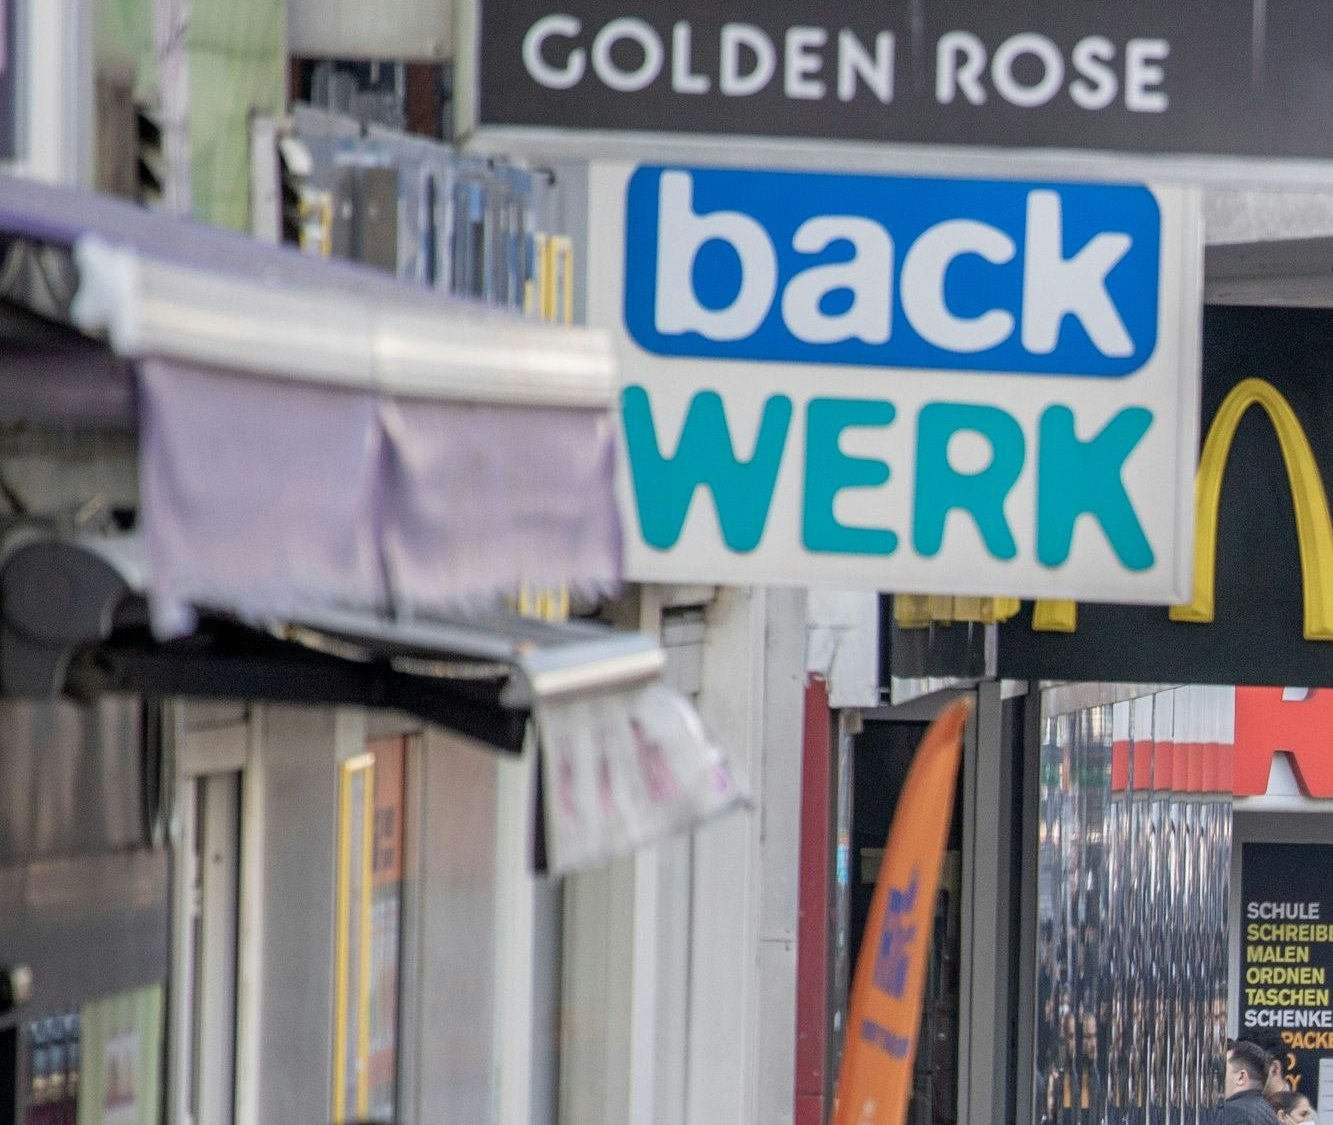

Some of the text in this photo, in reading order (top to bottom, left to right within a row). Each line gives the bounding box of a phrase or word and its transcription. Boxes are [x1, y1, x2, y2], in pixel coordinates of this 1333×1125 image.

[522, 13, 1172, 114] GOLDEN ROSE
[654, 170, 1136, 358] back
[622, 384, 1156, 572] WERK
[1246, 901, 1321, 920] SCHULE
[1246, 945, 1310, 963] MALEN
[1245, 966, 1326, 985] ORDNEN
[1245, 988, 1330, 1007] TASCHEN
